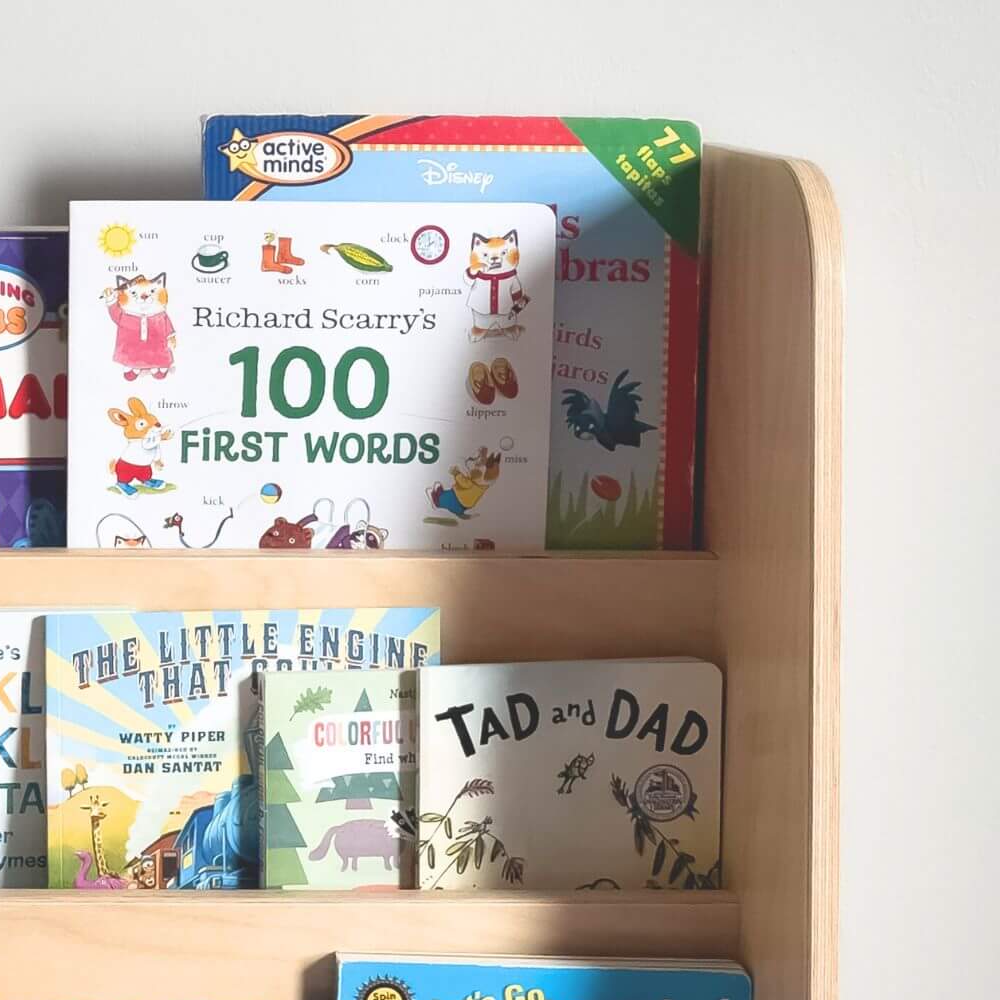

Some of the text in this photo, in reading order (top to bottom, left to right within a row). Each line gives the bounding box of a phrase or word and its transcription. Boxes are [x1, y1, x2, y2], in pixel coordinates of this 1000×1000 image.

[263, 139, 325, 156] active
[653, 126, 696, 164] 77
[263, 156, 325, 173] minds
[417, 159, 494, 194] Disney
[139, 231, 159, 240] sun
[204, 233, 224, 245] cup
[380, 232, 409, 243] clock
[108, 262, 138, 272] comb
[555, 248, 650, 283] bras
[196, 275, 232, 284] saucer
[278, 275, 307, 285] socks
[356, 277, 380, 286] corn
[419, 285, 463, 298] pajamas
[192, 307, 437, 335] Richard Scarry's
[553, 322, 603, 350] irds
[229, 345, 390, 419] 100
[158, 398, 189, 409] throw
[467, 407, 507, 420] slippers
[304, 432, 440, 464] WORDS
[504, 455, 528, 464] miss
[203, 496, 224, 506] kick
[72, 622, 428, 689] THE LITTLE ENGINE
[138, 660, 232, 708] THAT
[435, 688, 709, 758] TAD and DAD
[120, 731, 225, 744] WATTY PIPER
[314, 719, 404, 748] COLORFUL
[365, 753, 395, 765] Find
[123, 761, 222, 774] DAN SANTAT
